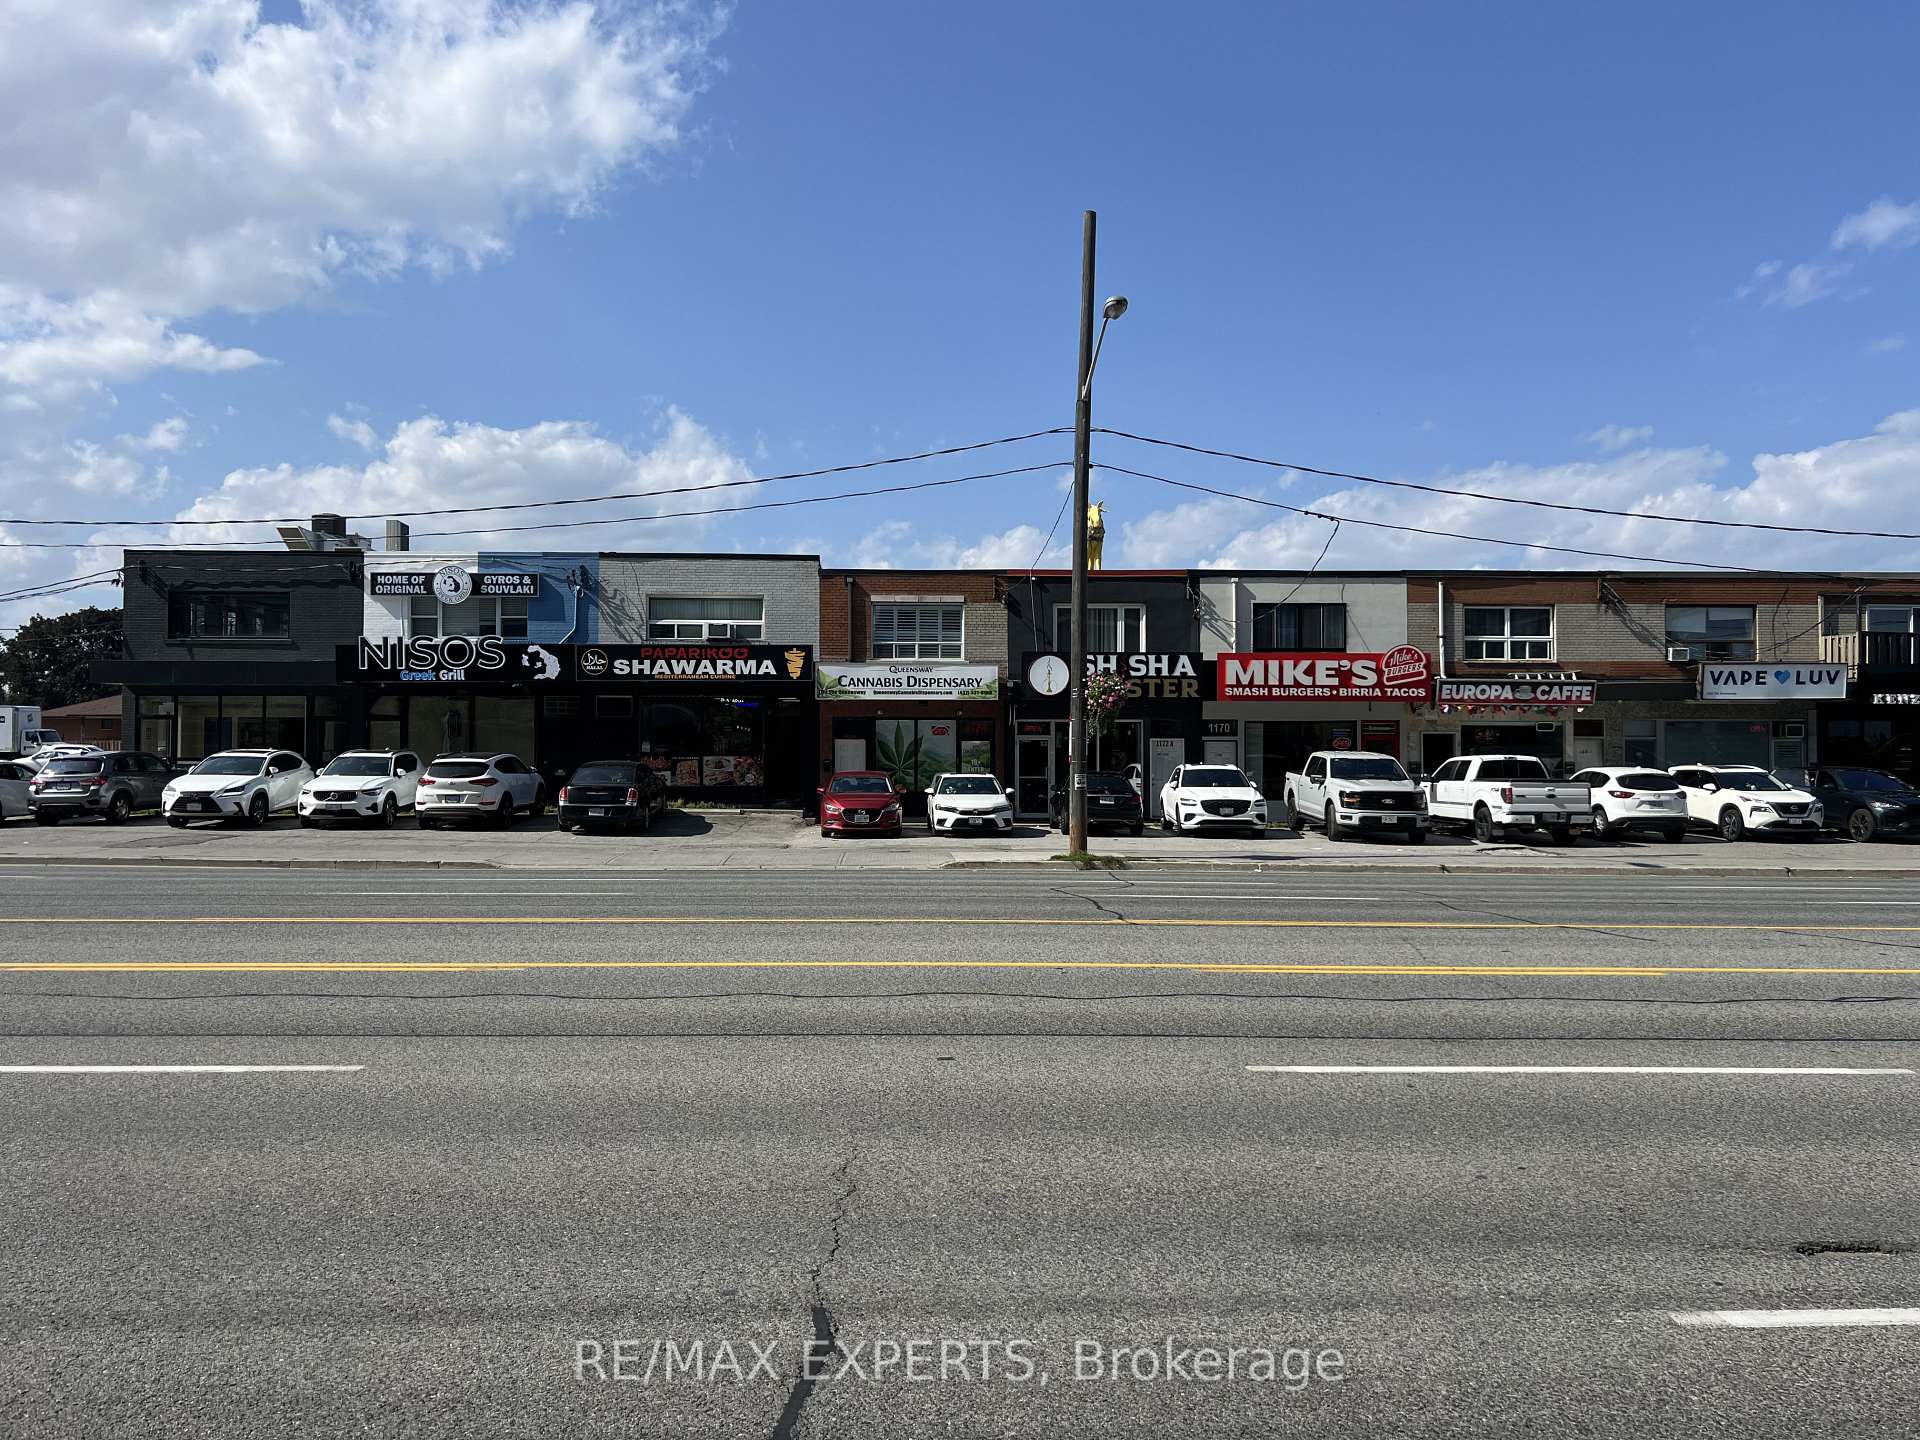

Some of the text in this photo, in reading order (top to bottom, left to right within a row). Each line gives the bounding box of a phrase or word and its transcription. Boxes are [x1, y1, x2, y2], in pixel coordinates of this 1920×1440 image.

[377, 575, 426, 584] HOME OF
[483, 575, 531, 584] GYROS &
[375, 585, 427, 594] ORIGINAL
[480, 585, 534, 594] SOUVLAKI
[359, 635, 506, 669] NISOS
[613, 659, 777, 675] SHAWARMA
[889, 665, 934, 674] QUEENSWAY
[1225, 659, 1378, 686] MIKE'S
[1387, 663, 1422, 676] BURGERS
[400, 669, 465, 681] Greek Grill
[1709, 670, 1840, 685] VAPE LUV
[837, 675, 983, 688] CANNABIS DISPENSARY
[1128, 678, 1200, 698] STER
[1225, 687, 1426, 697] SMASH BURGERS BIRRIA TACOS
[1441, 684, 1592, 701] EUROPA CAFFE
[1208, 723, 1230, 733] 1170
